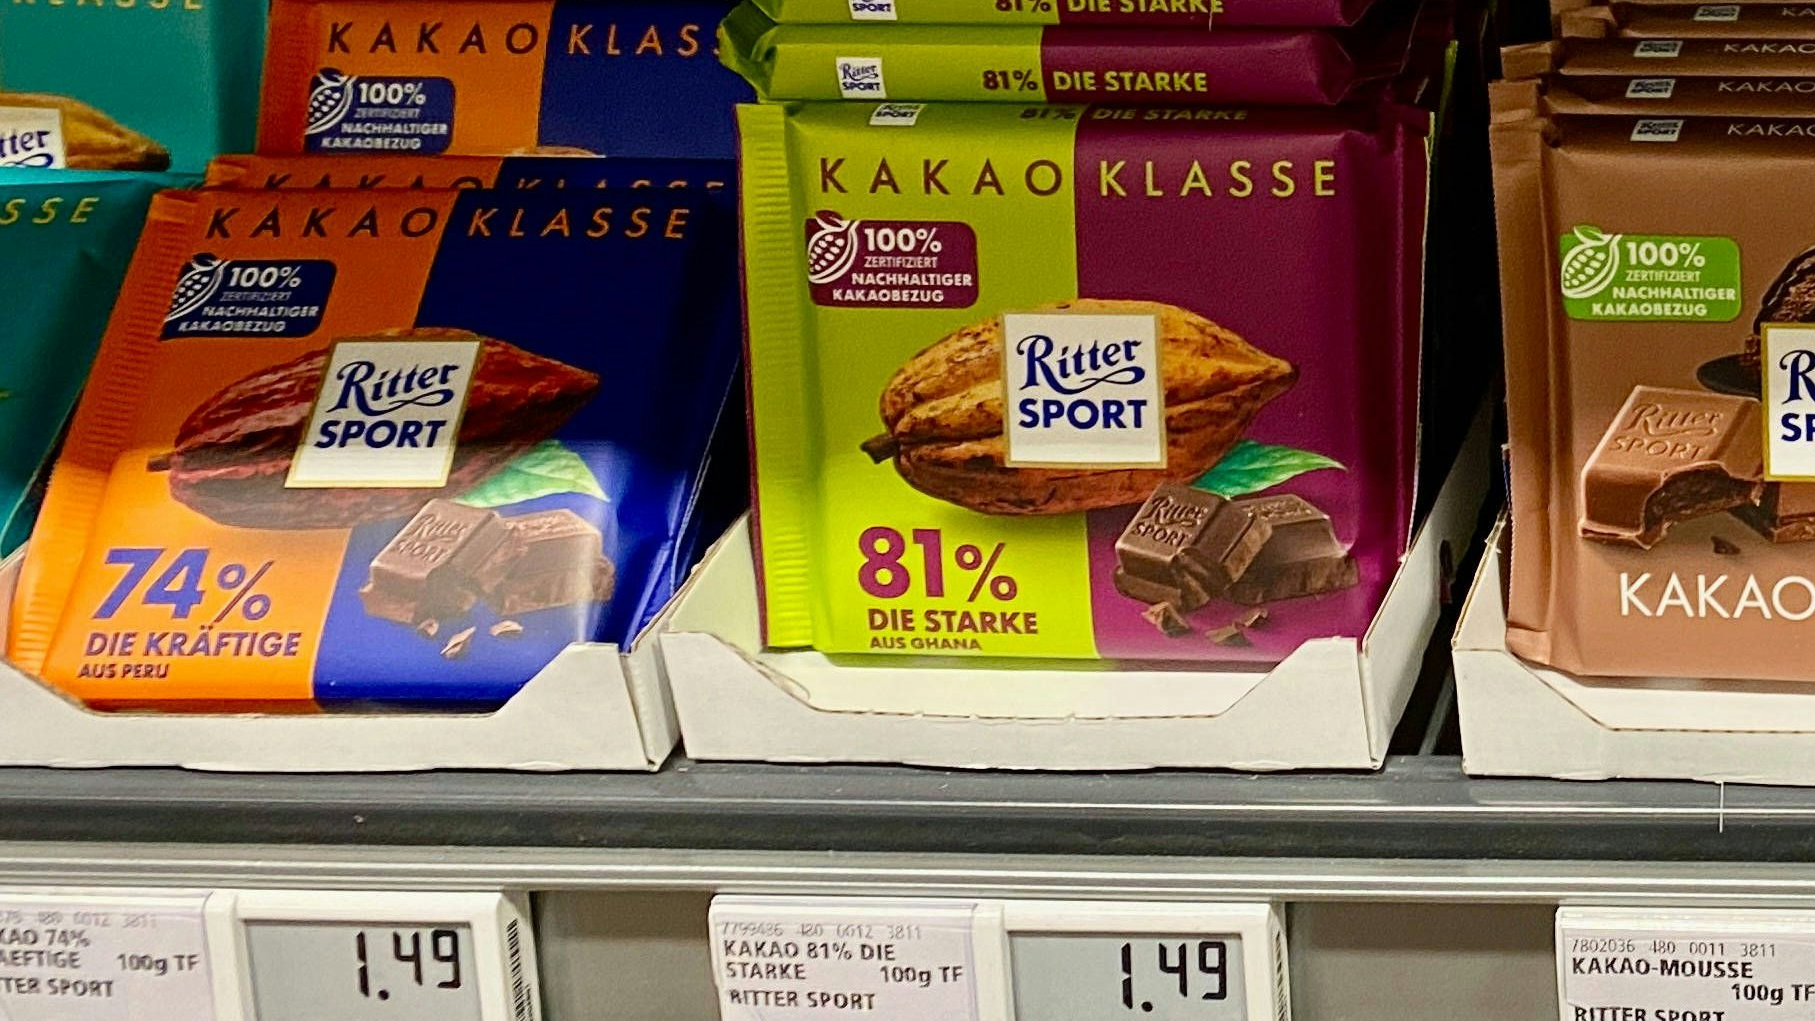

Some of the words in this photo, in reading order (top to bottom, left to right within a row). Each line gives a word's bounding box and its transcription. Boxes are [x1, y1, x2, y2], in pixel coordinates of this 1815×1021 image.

[852, 3, 891, 13] SPORT
[328, 22, 538, 54] KAKAO
[567, 24, 720, 56] KLAS
[359, 83, 426, 106] 100%
[341, 123, 448, 135] NACHHALTIGER
[321, 137, 421, 150] KAKAOBEZUG
[820, 158, 1063, 196] KAKAO
[1100, 160, 1336, 196] KLASSE
[205, 207, 440, 239] KAKAO
[468, 208, 690, 239] KLASSE
[864, 228, 942, 254] 100%
[864, 255, 938, 269] ZERTIFIZIERT
[1626, 242, 1706, 268] 100%
[229, 266, 302, 289] 100%
[851, 272, 972, 287] NACHHALTIGER
[1625, 270, 1701, 282] ZERTIFIZIERT
[833, 289, 944, 303] KAKAOBEZUG
[1613, 286, 1736, 302] NACHHALTIGER
[202, 305, 319, 318] NACHHALTIGER
[1592, 303, 1707, 316] KAKAOBEZUG
[178, 320, 287, 333] KAKAOBEZUG
[1018, 334, 1144, 395] Ritter
[329, 361, 458, 417] Ritter
[1019, 399, 1147, 429] SPORT
[315, 419, 449, 449] SPORT
[858, 526, 1018, 602] 81%
[92, 546, 275, 624] 74%
[868, 609, 917, 633] DIE
[924, 610, 1038, 635] STARKE
[85, 631, 139, 657] DIE
[143, 624, 302, 657] KRÄFTIGE
[870, 637, 905, 650] AUS
[909, 637, 982, 651] GHANA
[78, 664, 118, 679] AUS
[121, 664, 169, 679] PERU
[724, 942, 799, 960] KAKAO
[807, 942, 852, 961] 81%
[860, 943, 896, 961] DIE
[357, 930, 462, 1000] 1.49
[727, 962, 807, 980] STARKE
[880, 965, 932, 987] 100g
[938, 966, 964, 983] TF
[1121, 941, 1226, 1012] 1.49
[1573, 958, 1753, 978] KAKAO-MOUSSE
[730, 990, 801, 1008] RITTER
[808, 991, 876, 1010] SPORT
[1732, 983, 1783, 1005] 100g
[1791, 984, 1815, 1001] TF
